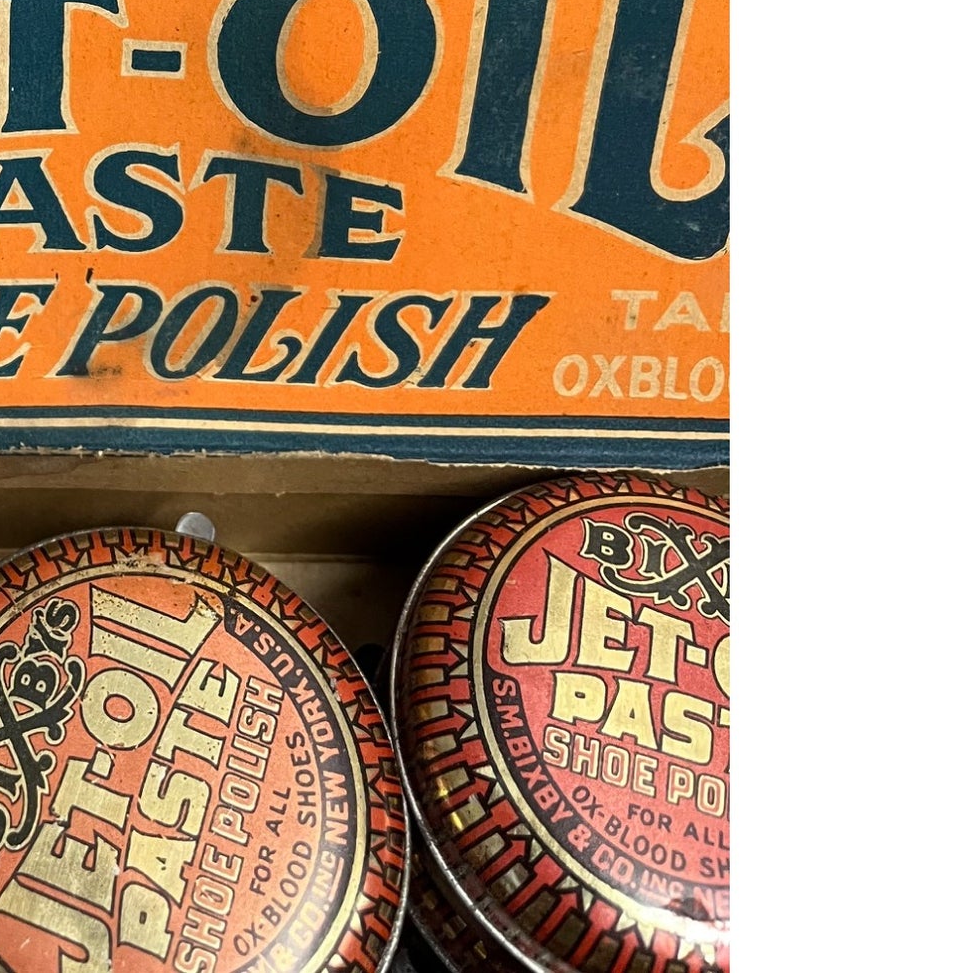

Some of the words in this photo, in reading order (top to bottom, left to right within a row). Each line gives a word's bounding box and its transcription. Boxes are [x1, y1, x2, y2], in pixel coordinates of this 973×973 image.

[47, 277, 556, 389] POLISH
[552, 354, 730, 403] OXBLO
[579, 512, 730, 627] BIX
[499, 548, 730, 698] JET-
[551, 670, 730, 765] PAS
[117, 655, 242, 963] PASTE
[323, 771, 349, 845] NEW
[542, 725, 658, 797] SHOE
[666, 762, 730, 817] PO
[173, 844, 244, 973] SHOE
[210, 674, 285, 847] POLISH
[233, 840, 312, 957] OX-BLOOD
[285, 730, 317, 827] SHOES
[250, 845, 277, 896] FOR
[266, 785, 291, 837] ALL
[567, 823, 592, 852] &
[572, 785, 687, 871] OX-BLOOD
[700, 857, 730, 880] SH
[627, 803, 672, 833] FOR
[683, 821, 730, 851] ALL
